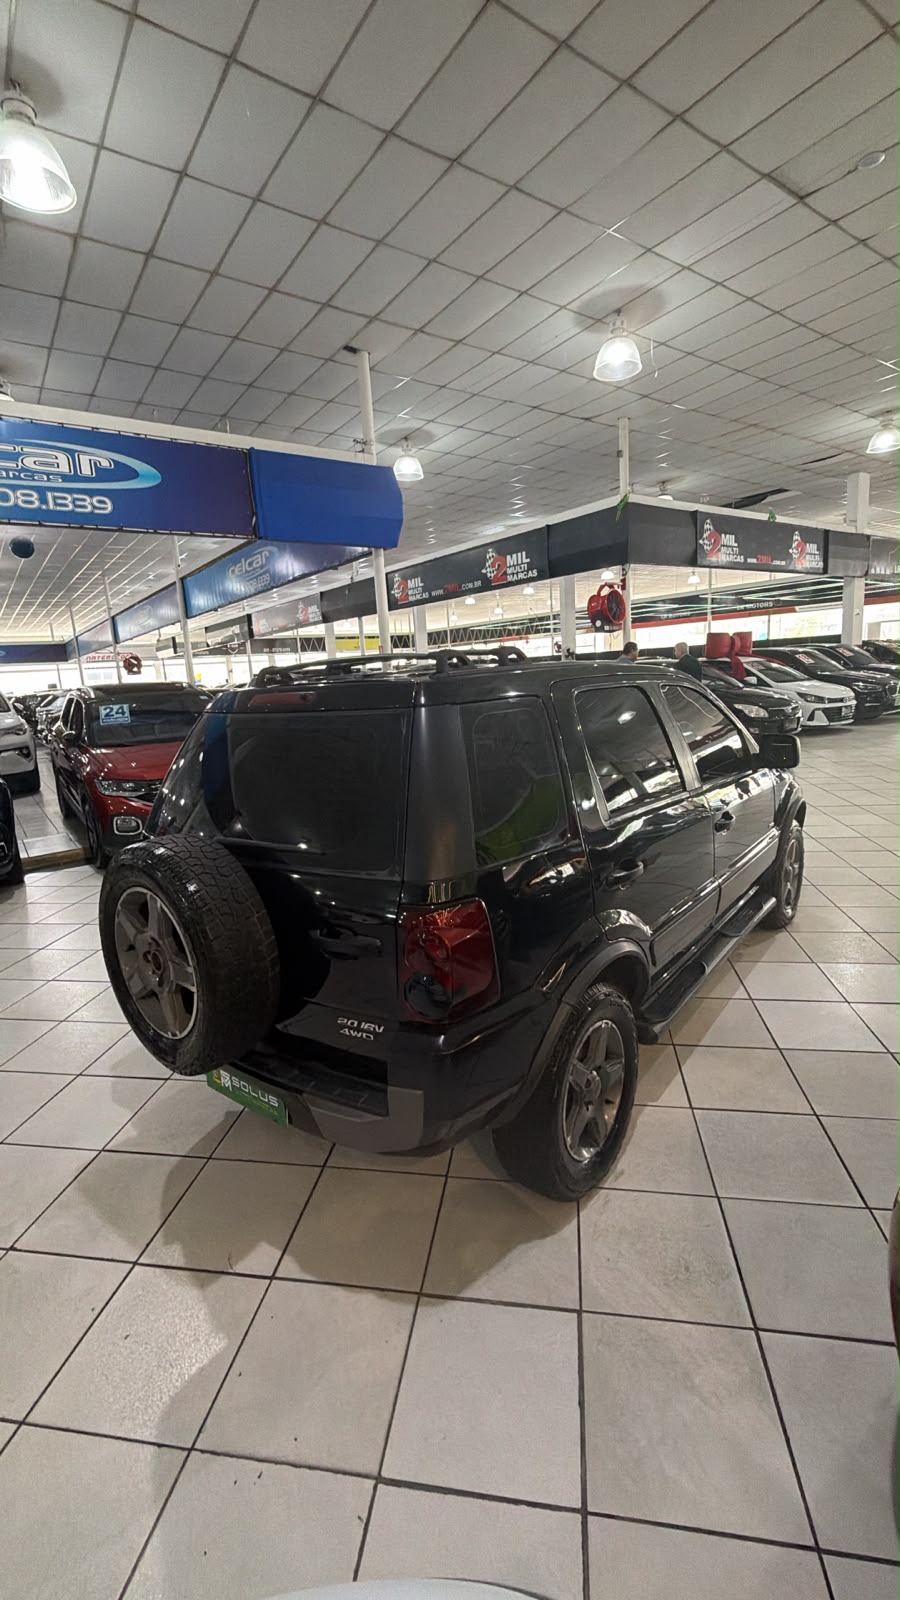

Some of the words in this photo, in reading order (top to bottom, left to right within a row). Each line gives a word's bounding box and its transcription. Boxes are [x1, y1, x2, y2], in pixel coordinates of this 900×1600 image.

[707, 530, 721, 558] 2
[721, 533, 738, 547] MIL
[806, 543, 820, 554] MIL
[721, 546, 739, 554] MULTI
[720, 554, 744, 563] MARCAS
[491, 555, 507, 585] 2
[507, 551, 531, 567] MIL
[507, 564, 528, 575] MULTI
[507, 569, 538, 582] MARCAS
[398, 579, 409, 604] 2
[408, 577, 424, 589] MIL
[408, 587, 423, 595] MULTI
[408, 592, 430, 601] MARCAS
[103, 705, 126, 717] 24
[232, 1076, 279, 1107] SOLUS
